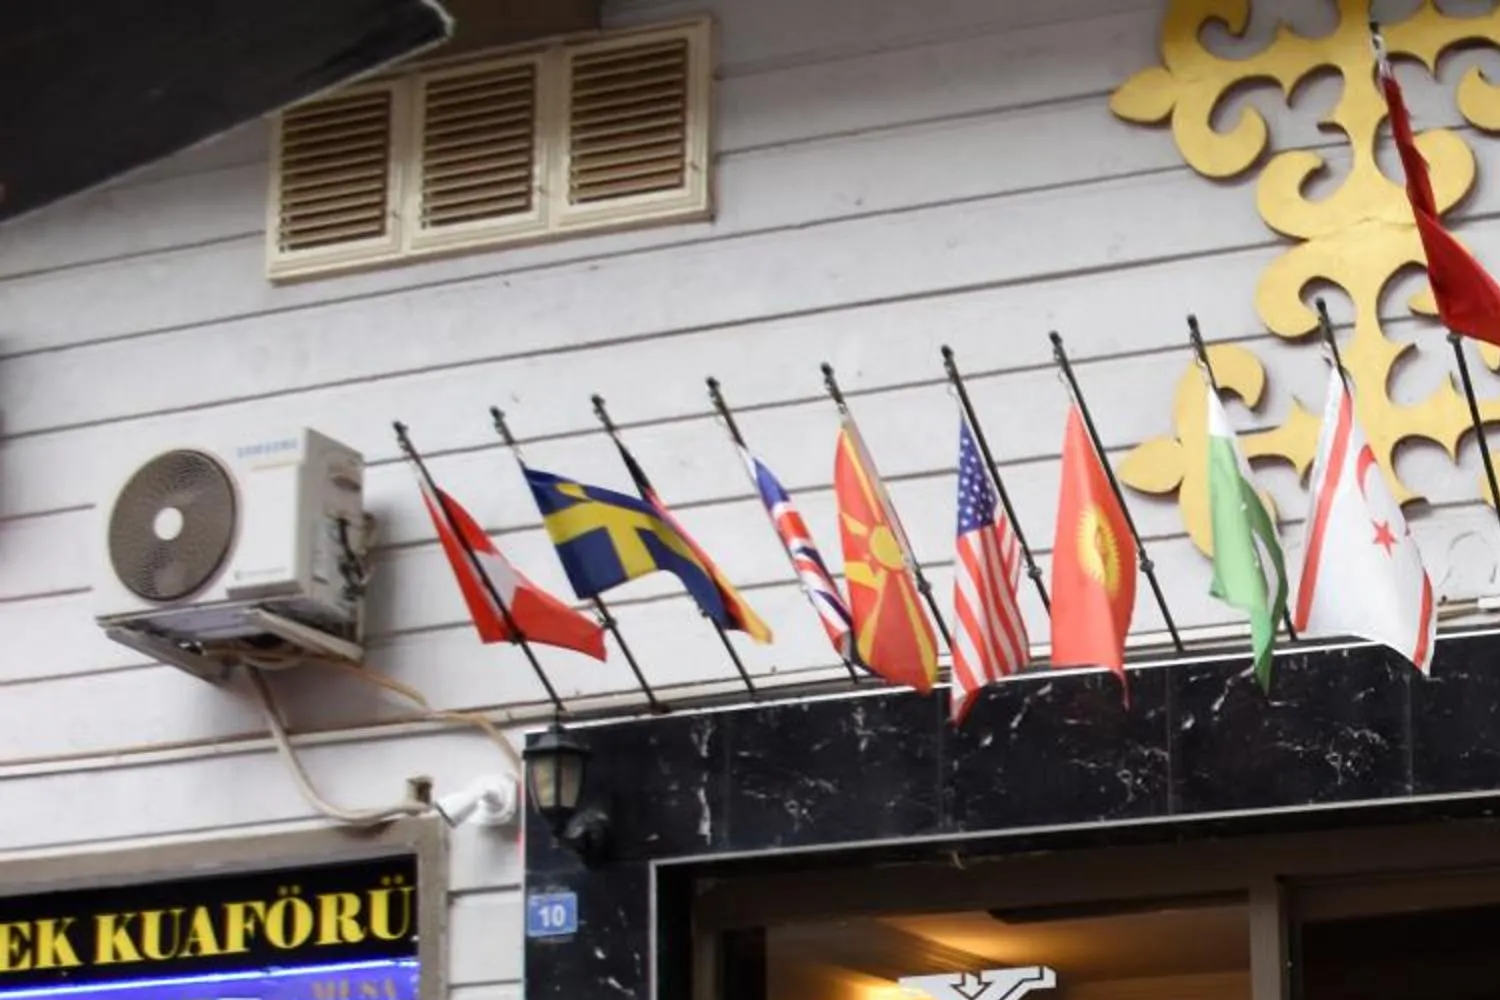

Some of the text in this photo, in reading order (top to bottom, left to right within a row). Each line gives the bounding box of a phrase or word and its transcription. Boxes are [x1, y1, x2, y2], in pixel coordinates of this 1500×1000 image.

[0, 875, 415, 973] EK KUAFÖRÜ
[538, 904, 567, 928] 10
